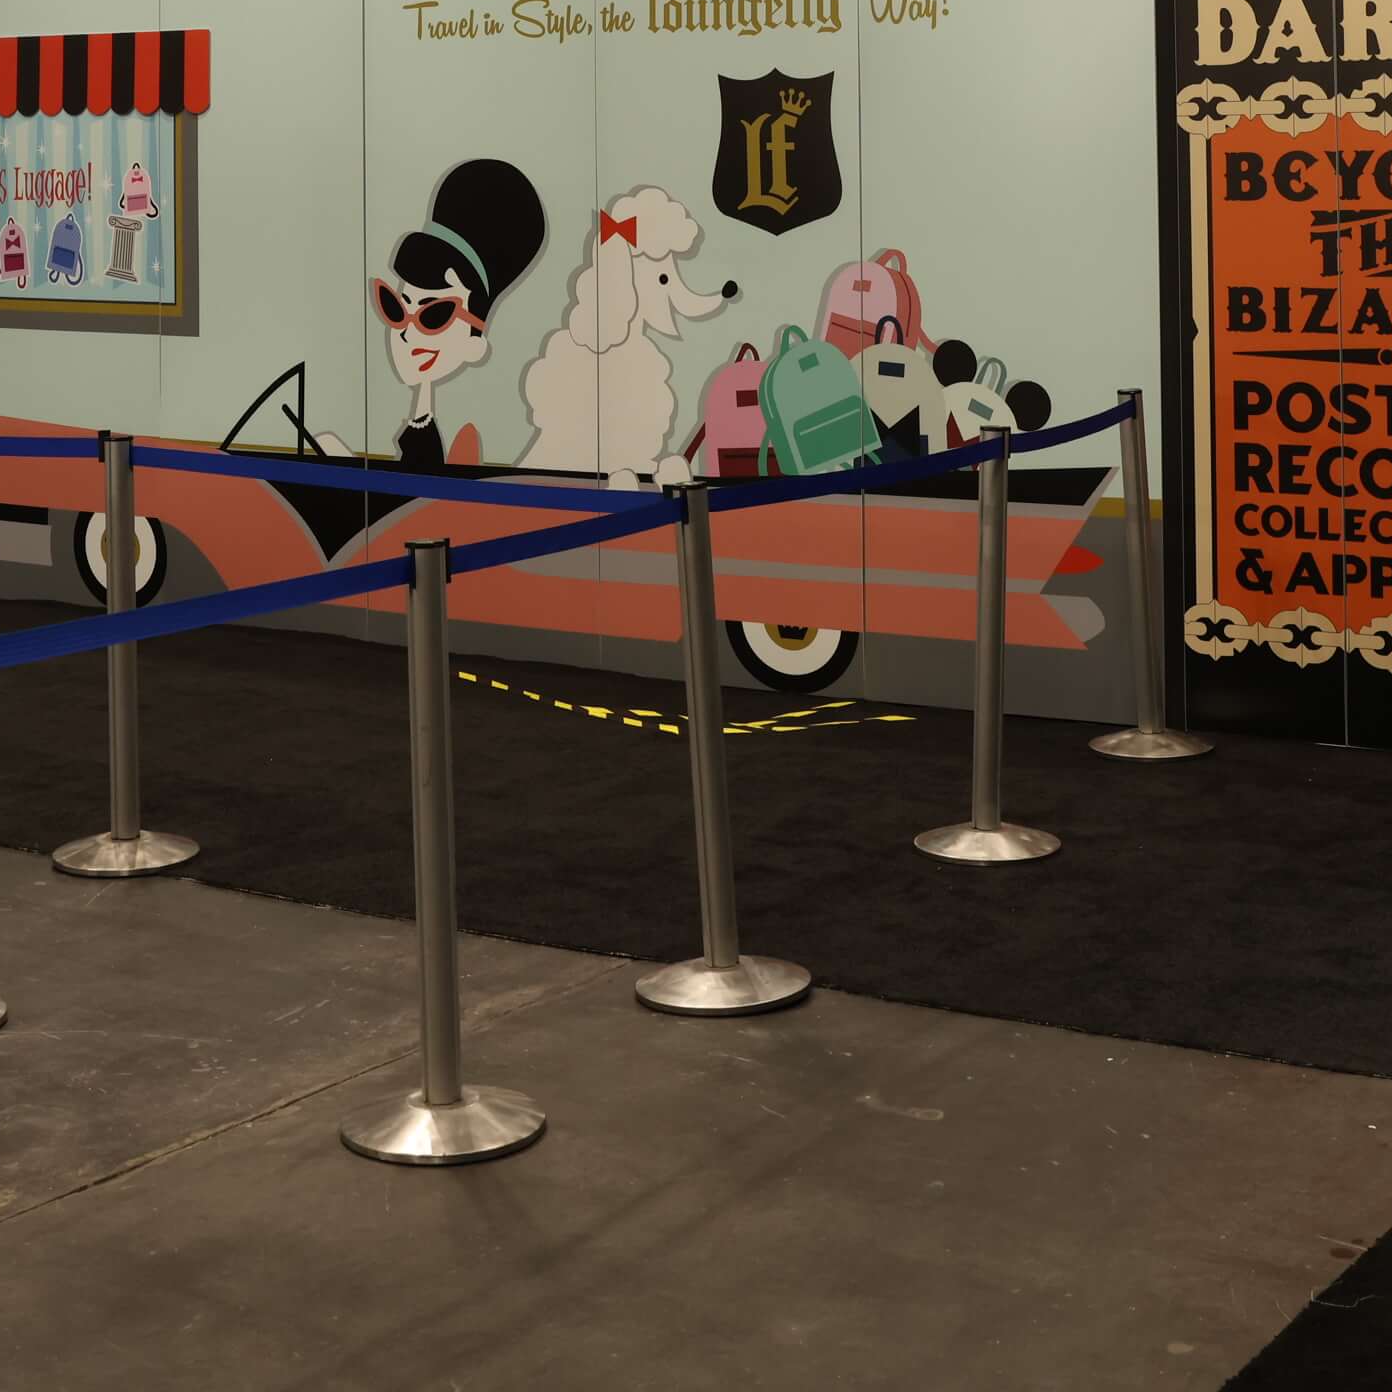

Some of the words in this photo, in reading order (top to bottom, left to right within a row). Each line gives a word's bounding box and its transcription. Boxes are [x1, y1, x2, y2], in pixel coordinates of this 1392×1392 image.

[403, 1, 478, 42] Travel
[484, 13, 503, 37] in
[600, 3, 635, 34] the
[14, 161, 93, 205] Luggage!
[1236, 548, 1273, 595] &
